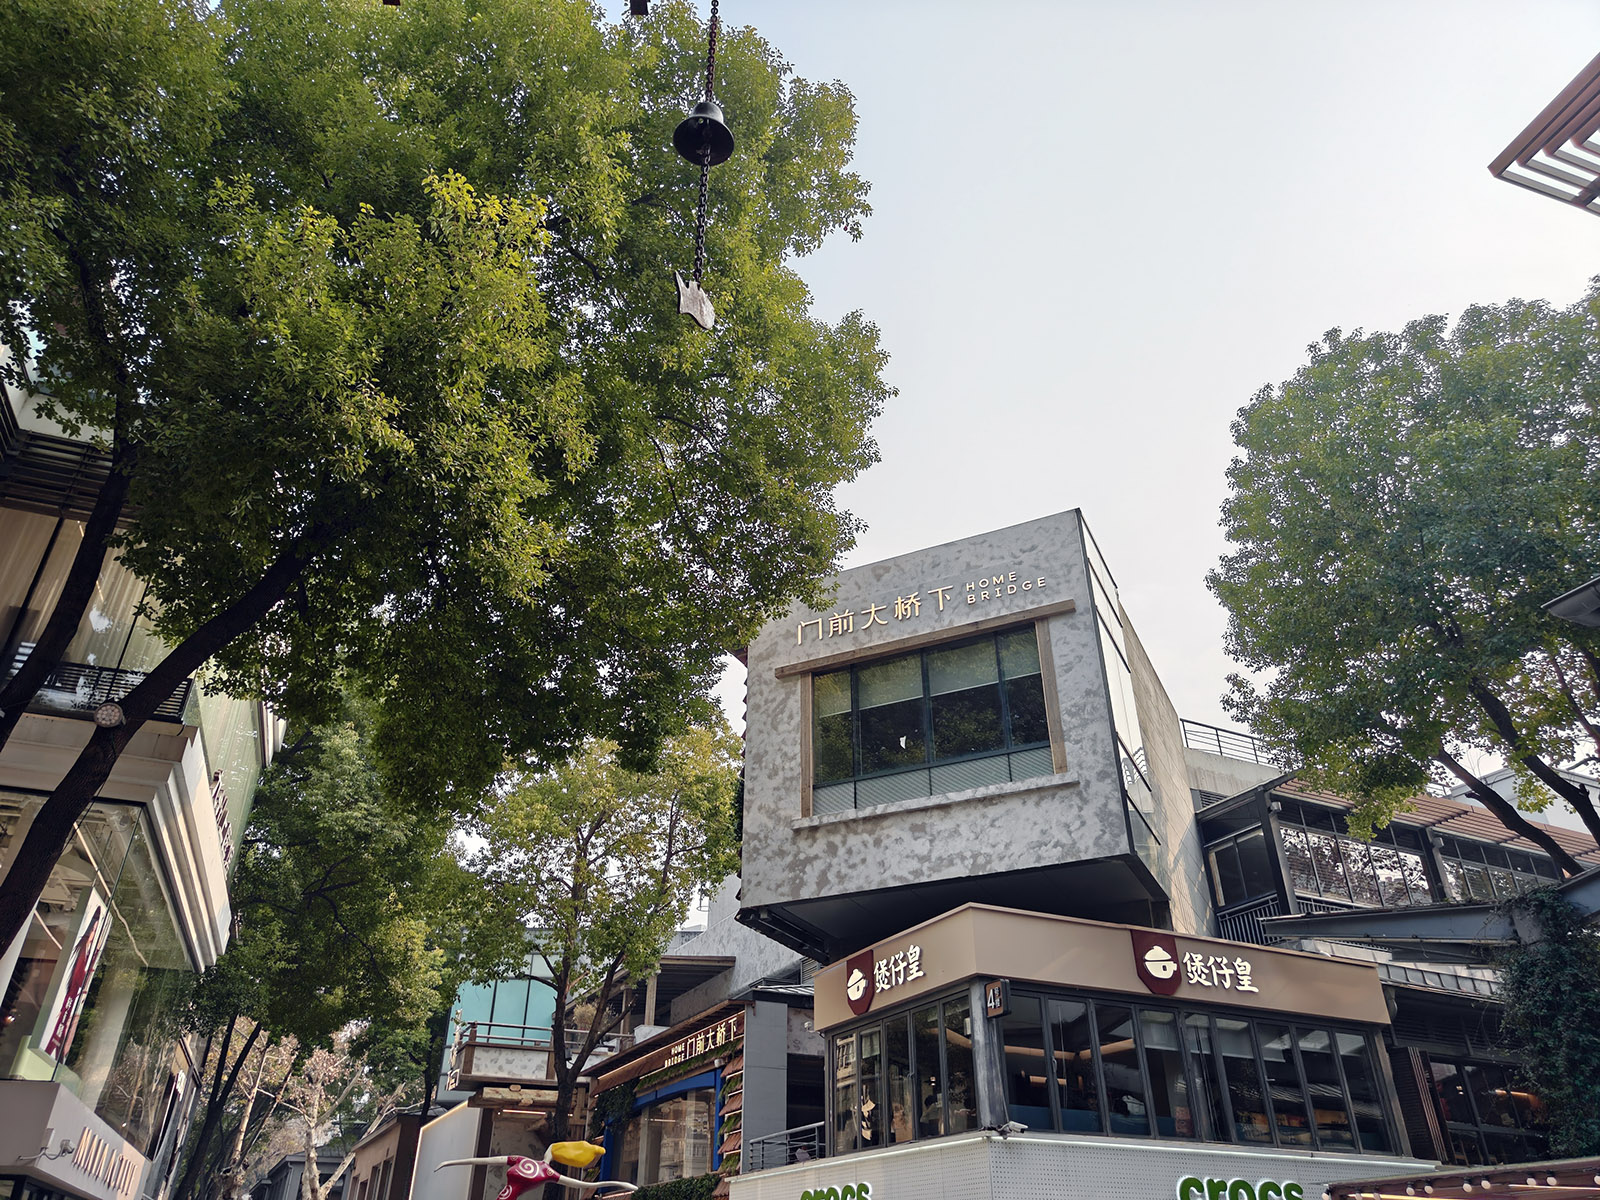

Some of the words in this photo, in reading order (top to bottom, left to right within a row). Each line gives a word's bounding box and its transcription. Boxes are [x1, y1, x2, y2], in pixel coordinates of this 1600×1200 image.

[966, 571, 1017, 592] HOME
[967, 576, 1046, 605] BRIDGE
[797, 584, 954, 646] 门前大桥下
[873, 944, 924, 993] 煲仔皇
[1183, 951, 1259, 993] 煲仔皇
[686, 1016, 738, 1060] 门前大桥下
[1178, 1176, 1304, 1200] crocs
